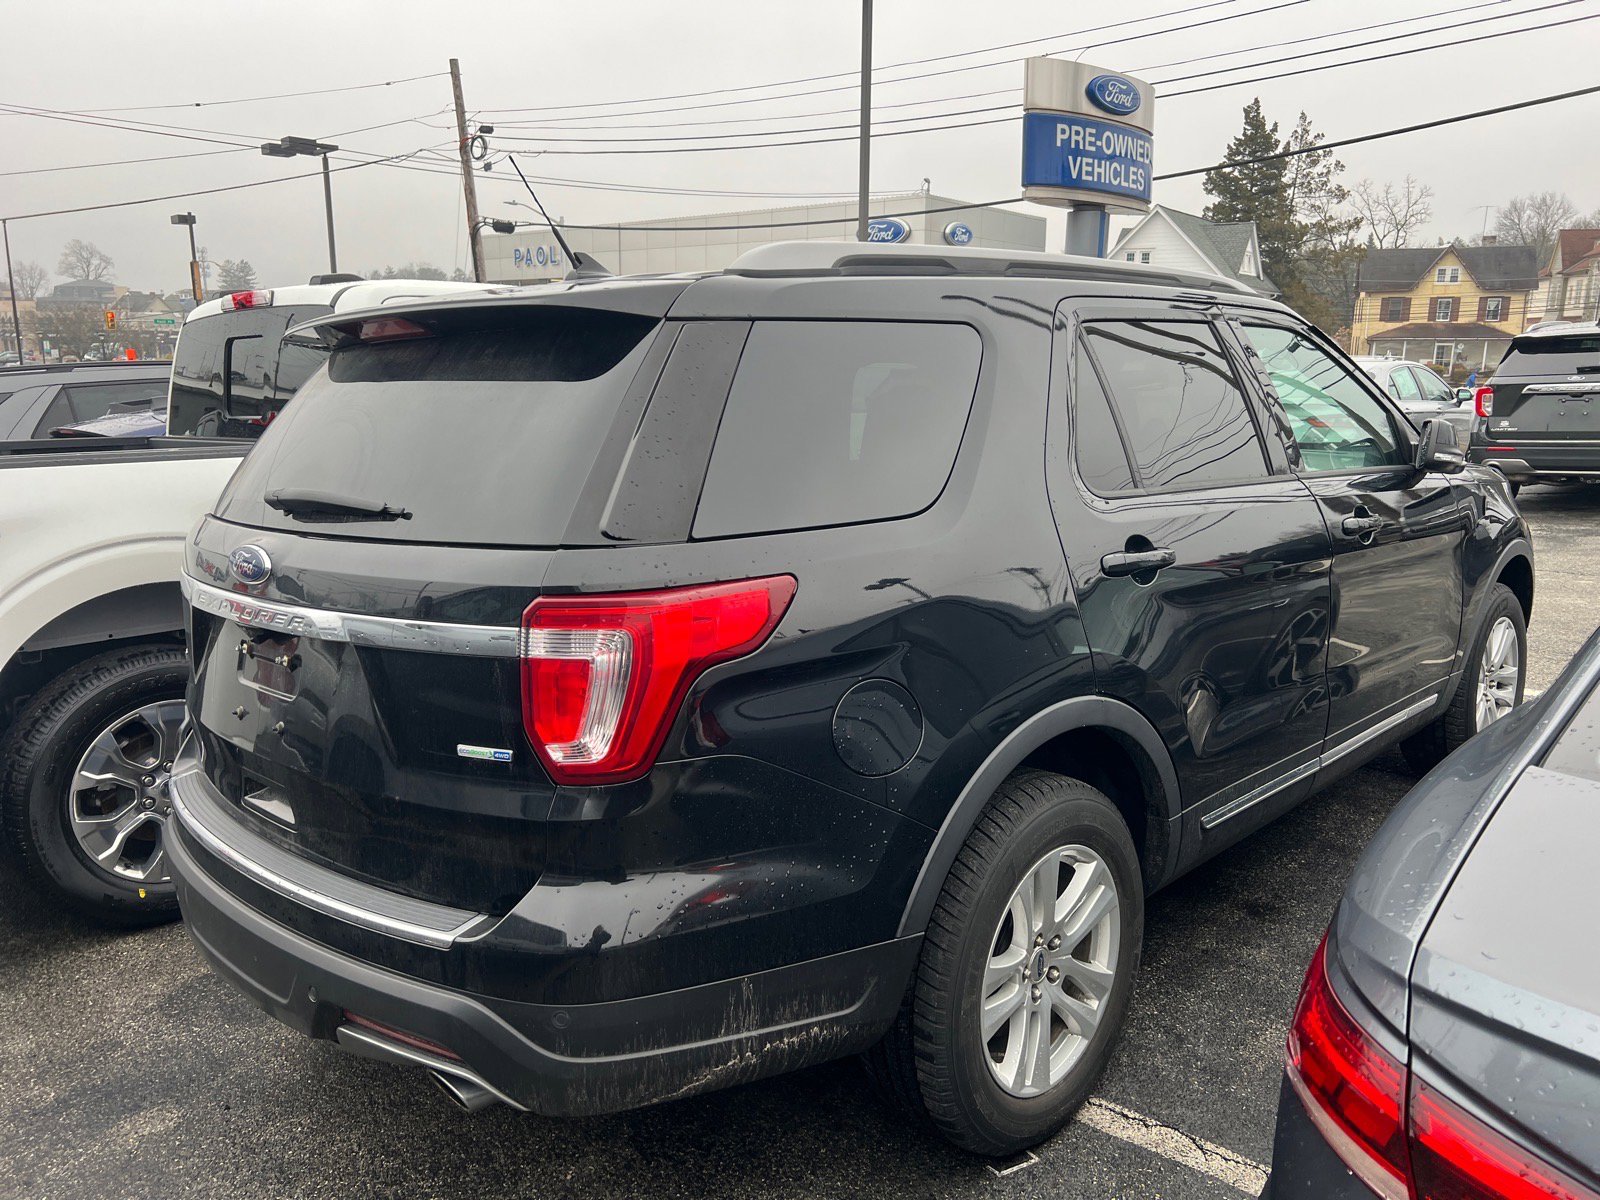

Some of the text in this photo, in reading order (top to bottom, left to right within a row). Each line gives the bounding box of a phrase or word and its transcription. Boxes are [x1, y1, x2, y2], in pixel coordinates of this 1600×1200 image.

[1104, 81, 1134, 107] Ford
[1056, 123, 1152, 164] PRE-OWNED
[1068, 155, 1145, 191] VEHICLES
[867, 223, 895, 242] Ford
[954, 227, 969, 242] Ford
[513, 245, 562, 267] PAOL
[232, 550, 256, 576] Ford
[198, 592, 306, 632] EXPLORER
